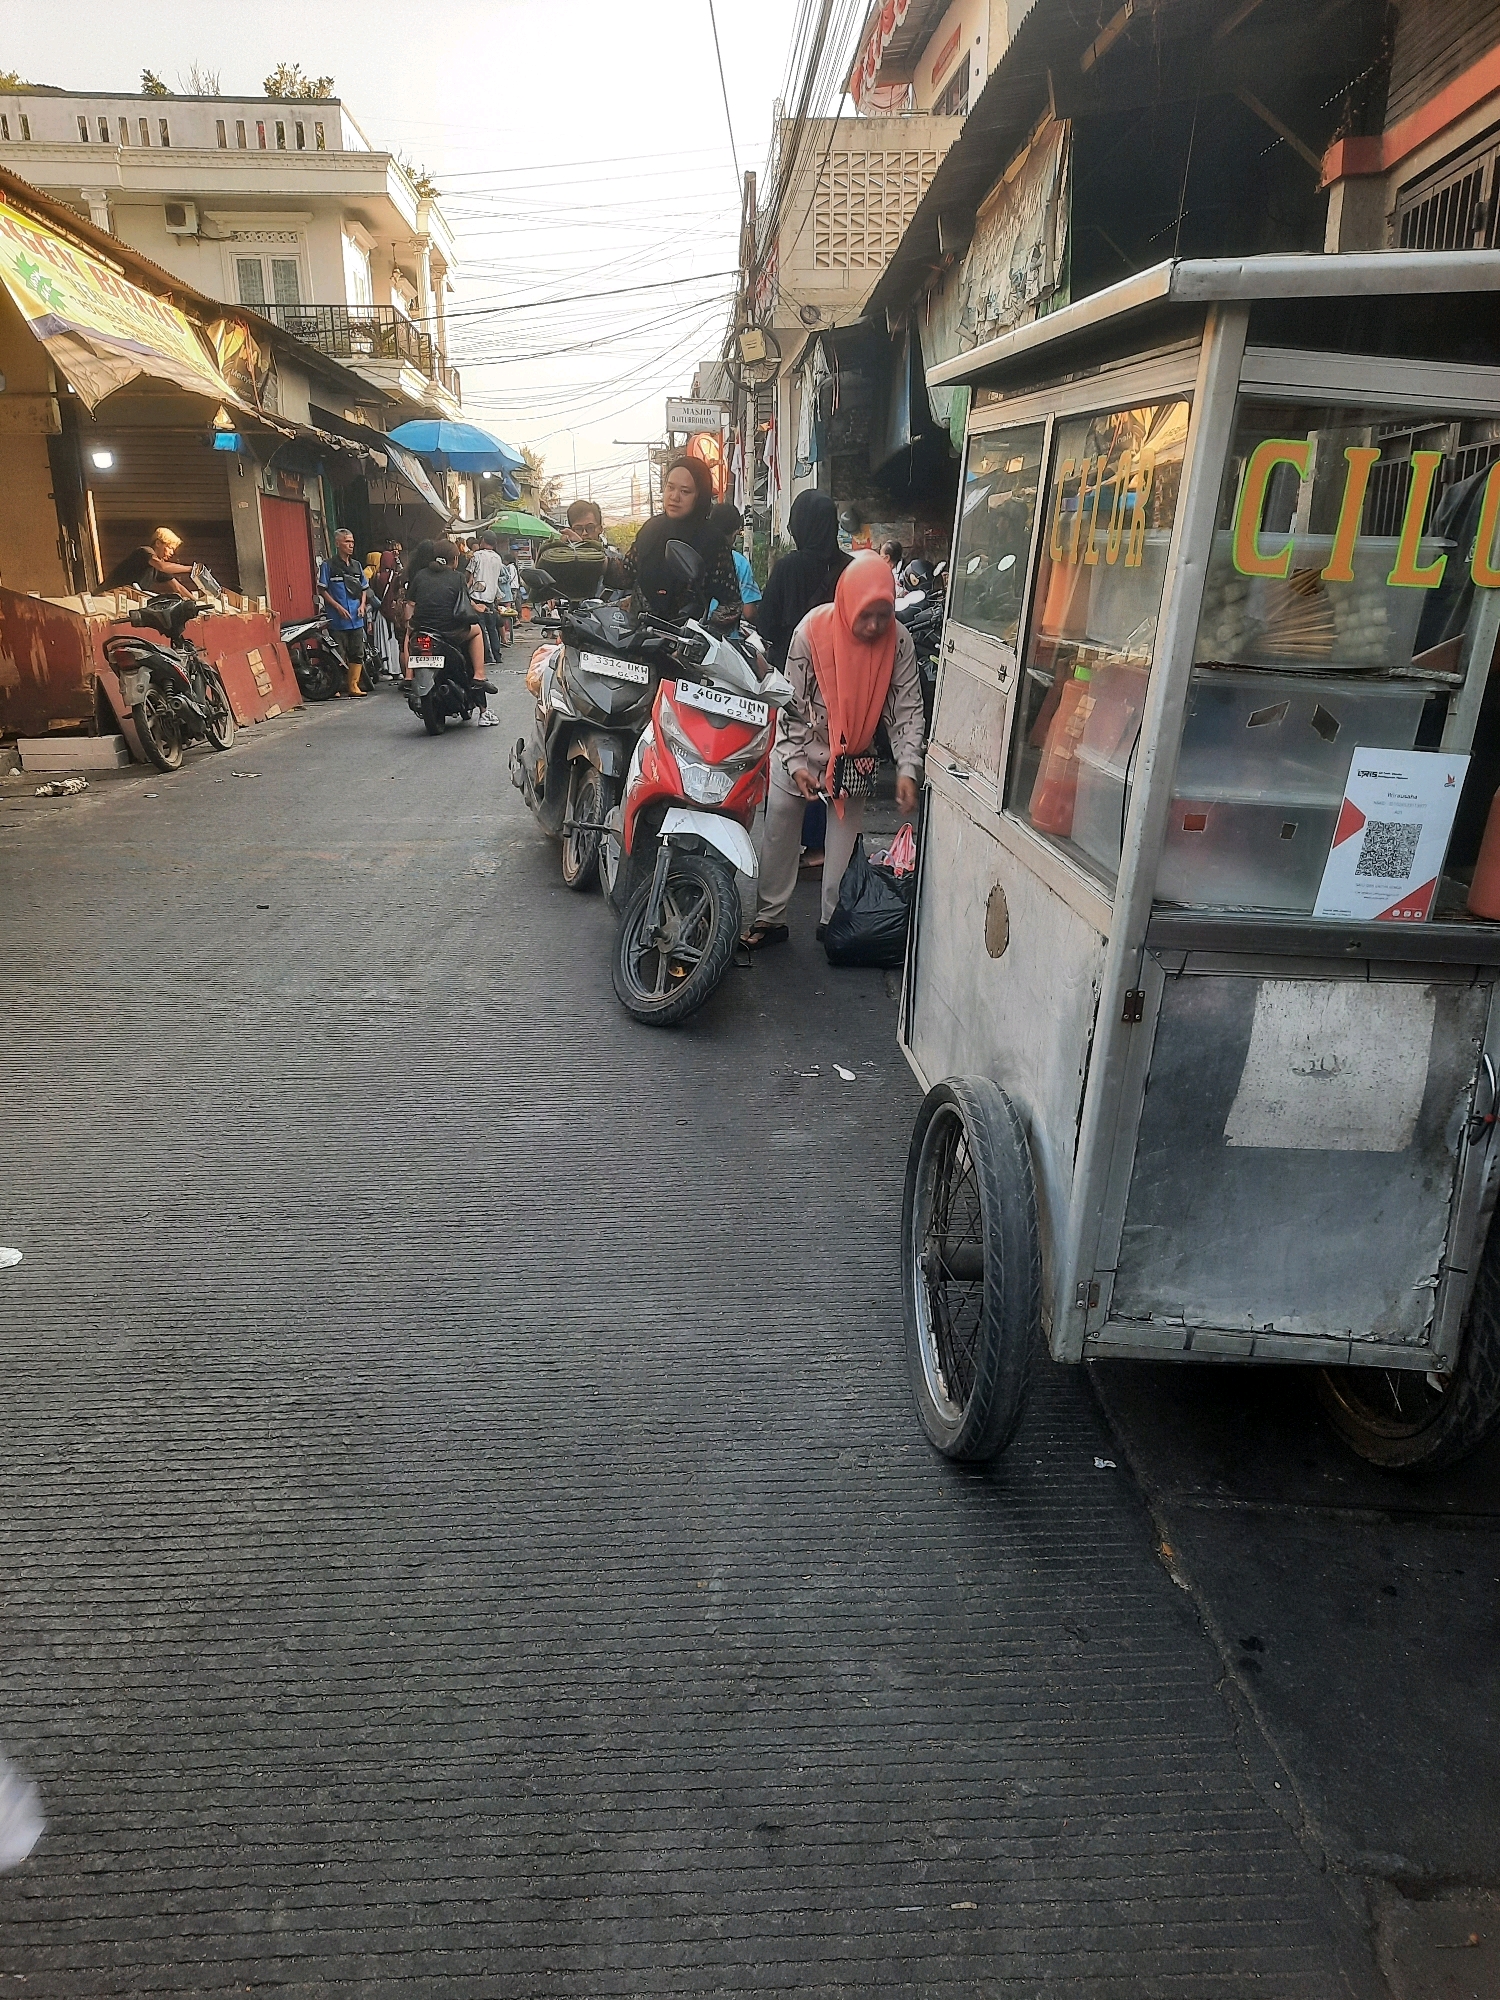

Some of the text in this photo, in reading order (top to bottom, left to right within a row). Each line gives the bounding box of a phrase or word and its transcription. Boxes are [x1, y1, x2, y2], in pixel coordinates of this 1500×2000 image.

[83, 260, 186, 335] BERAS
[682, 407, 712, 416] MASJID
[1050, 447, 1156, 568] CILOR
[582, 653, 589, 661] B
[681, 682, 765, 715] B 4007 UMN
